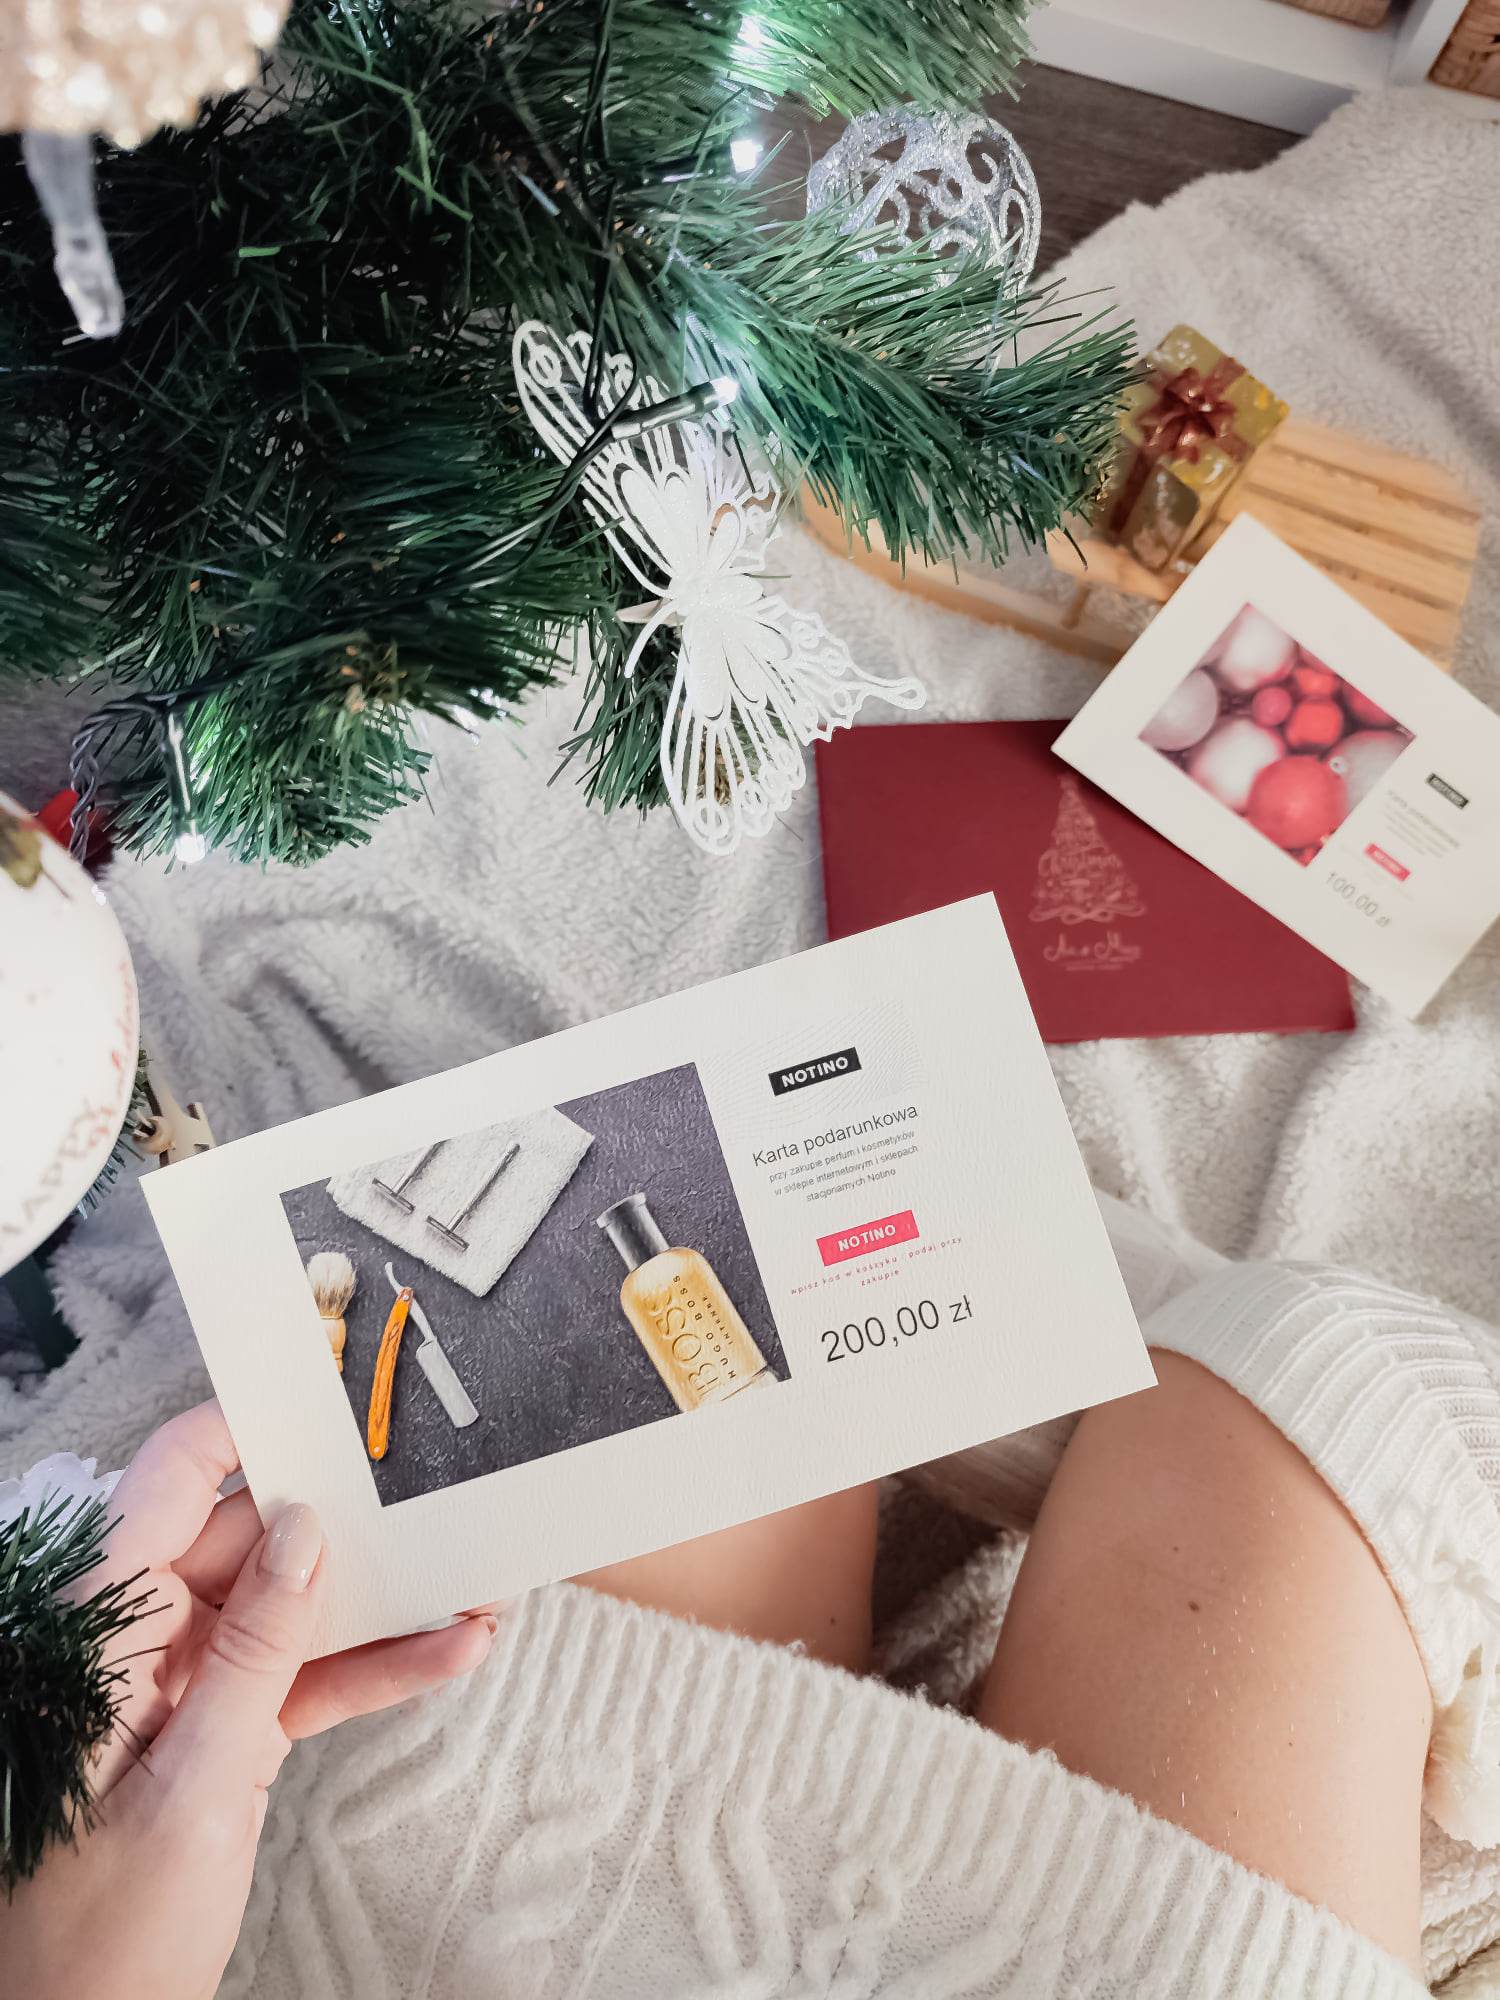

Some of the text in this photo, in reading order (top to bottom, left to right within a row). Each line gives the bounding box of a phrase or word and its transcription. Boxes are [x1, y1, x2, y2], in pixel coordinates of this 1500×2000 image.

[781, 1056, 849, 1088] NOTINO
[753, 1106, 918, 1167] Karta podarunkowa
[769, 1169, 788, 1184] przy
[790, 1159, 824, 1176] zakupie
[825, 1148, 856, 1166] perfum
[784, 1178, 815, 1195] sklepie
[816, 1158, 874, 1184] internetowym
[880, 1144, 919, 1164] sklepach
[867, 1167, 897, 1182] Notino
[837, 1224, 897, 1252] NOTINO
[860, 1269, 900, 1287] zakupie
[673, 1275, 736, 1379] HUGO BOSS
[821, 1294, 973, 1363] 200,00 zł
